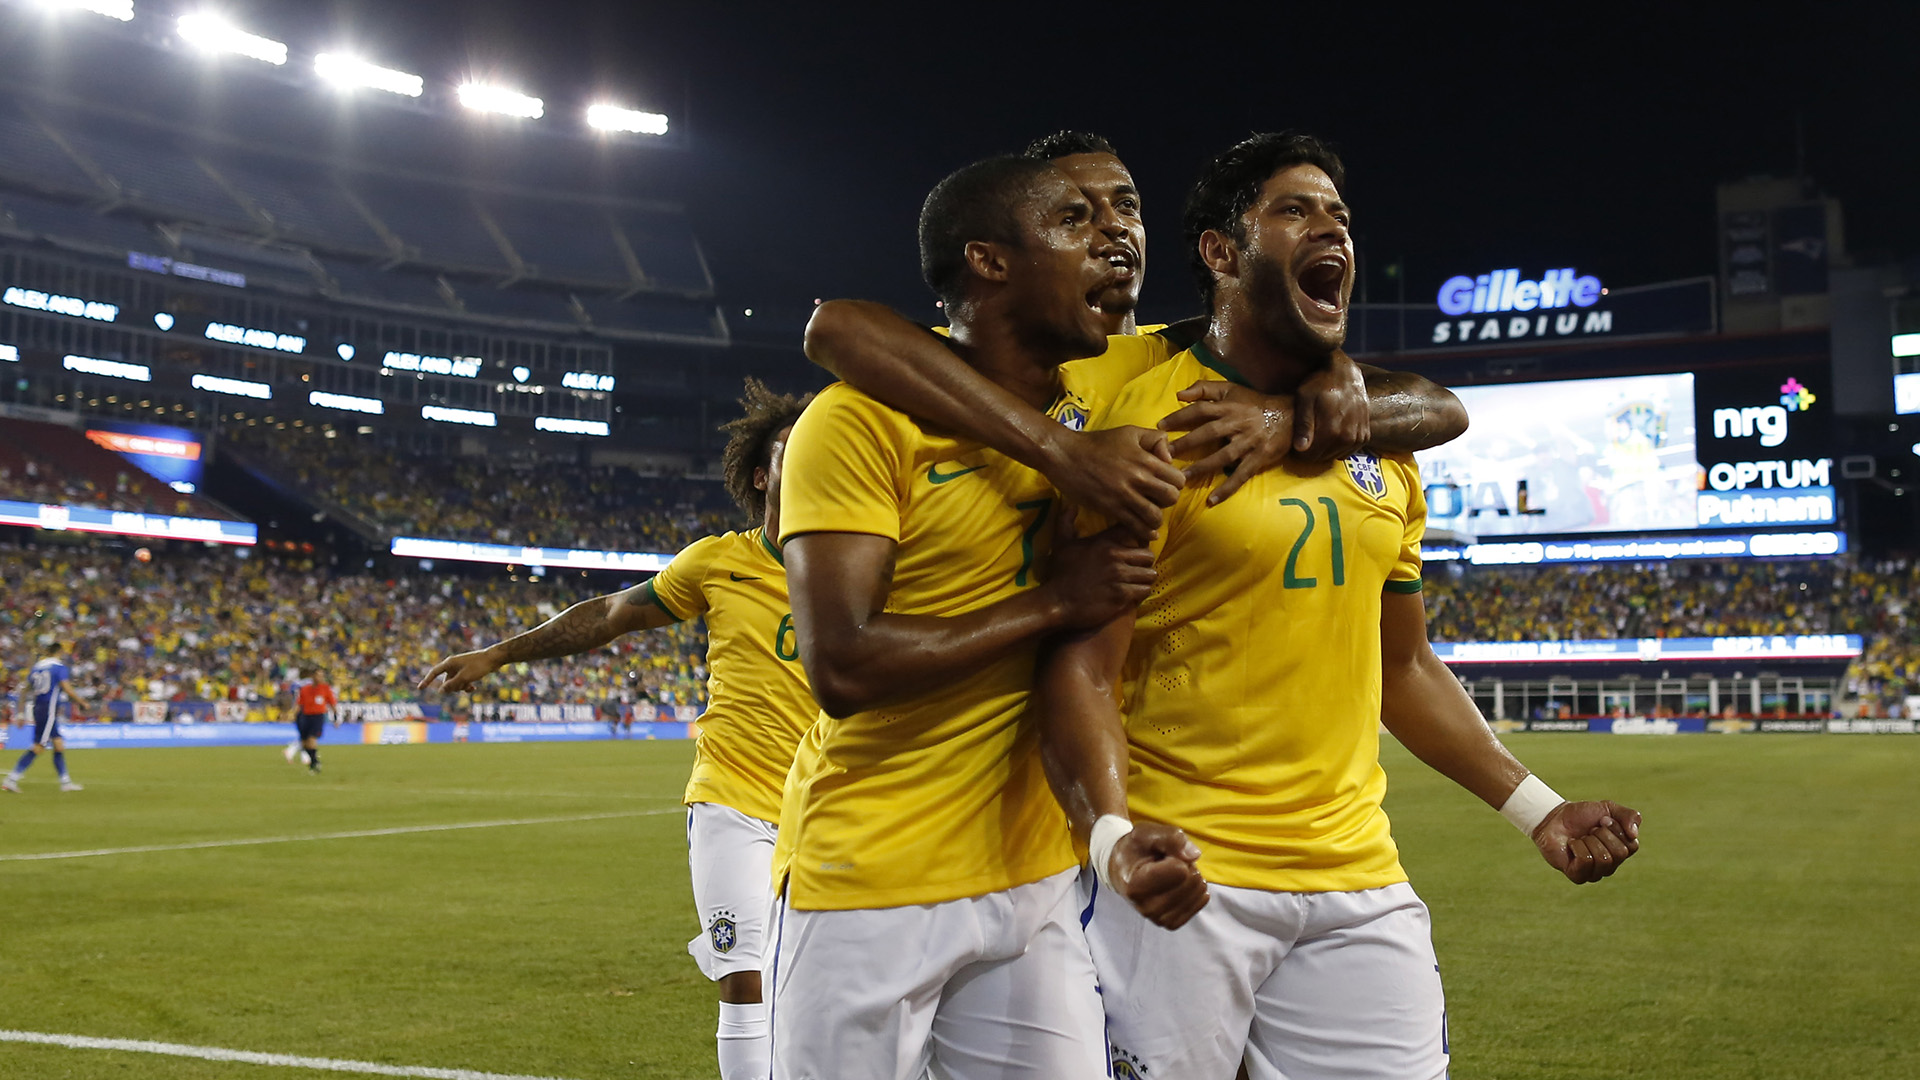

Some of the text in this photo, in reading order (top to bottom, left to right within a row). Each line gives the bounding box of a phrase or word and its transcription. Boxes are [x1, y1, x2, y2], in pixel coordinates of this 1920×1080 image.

[1437, 268, 1601, 316] Gillette
[1432, 310, 1612, 343] STADIUM
[1714, 405, 1788, 447] nrg
[1356, 463, 1372, 472] CBF
[1708, 458, 1830, 491] OPTUM
[1424, 479, 1546, 518] OAL
[1698, 494, 1833, 524] Putnam
[1014, 498, 1053, 587] 7
[1279, 496, 1345, 589] 21
[775, 612, 799, 661] 6
